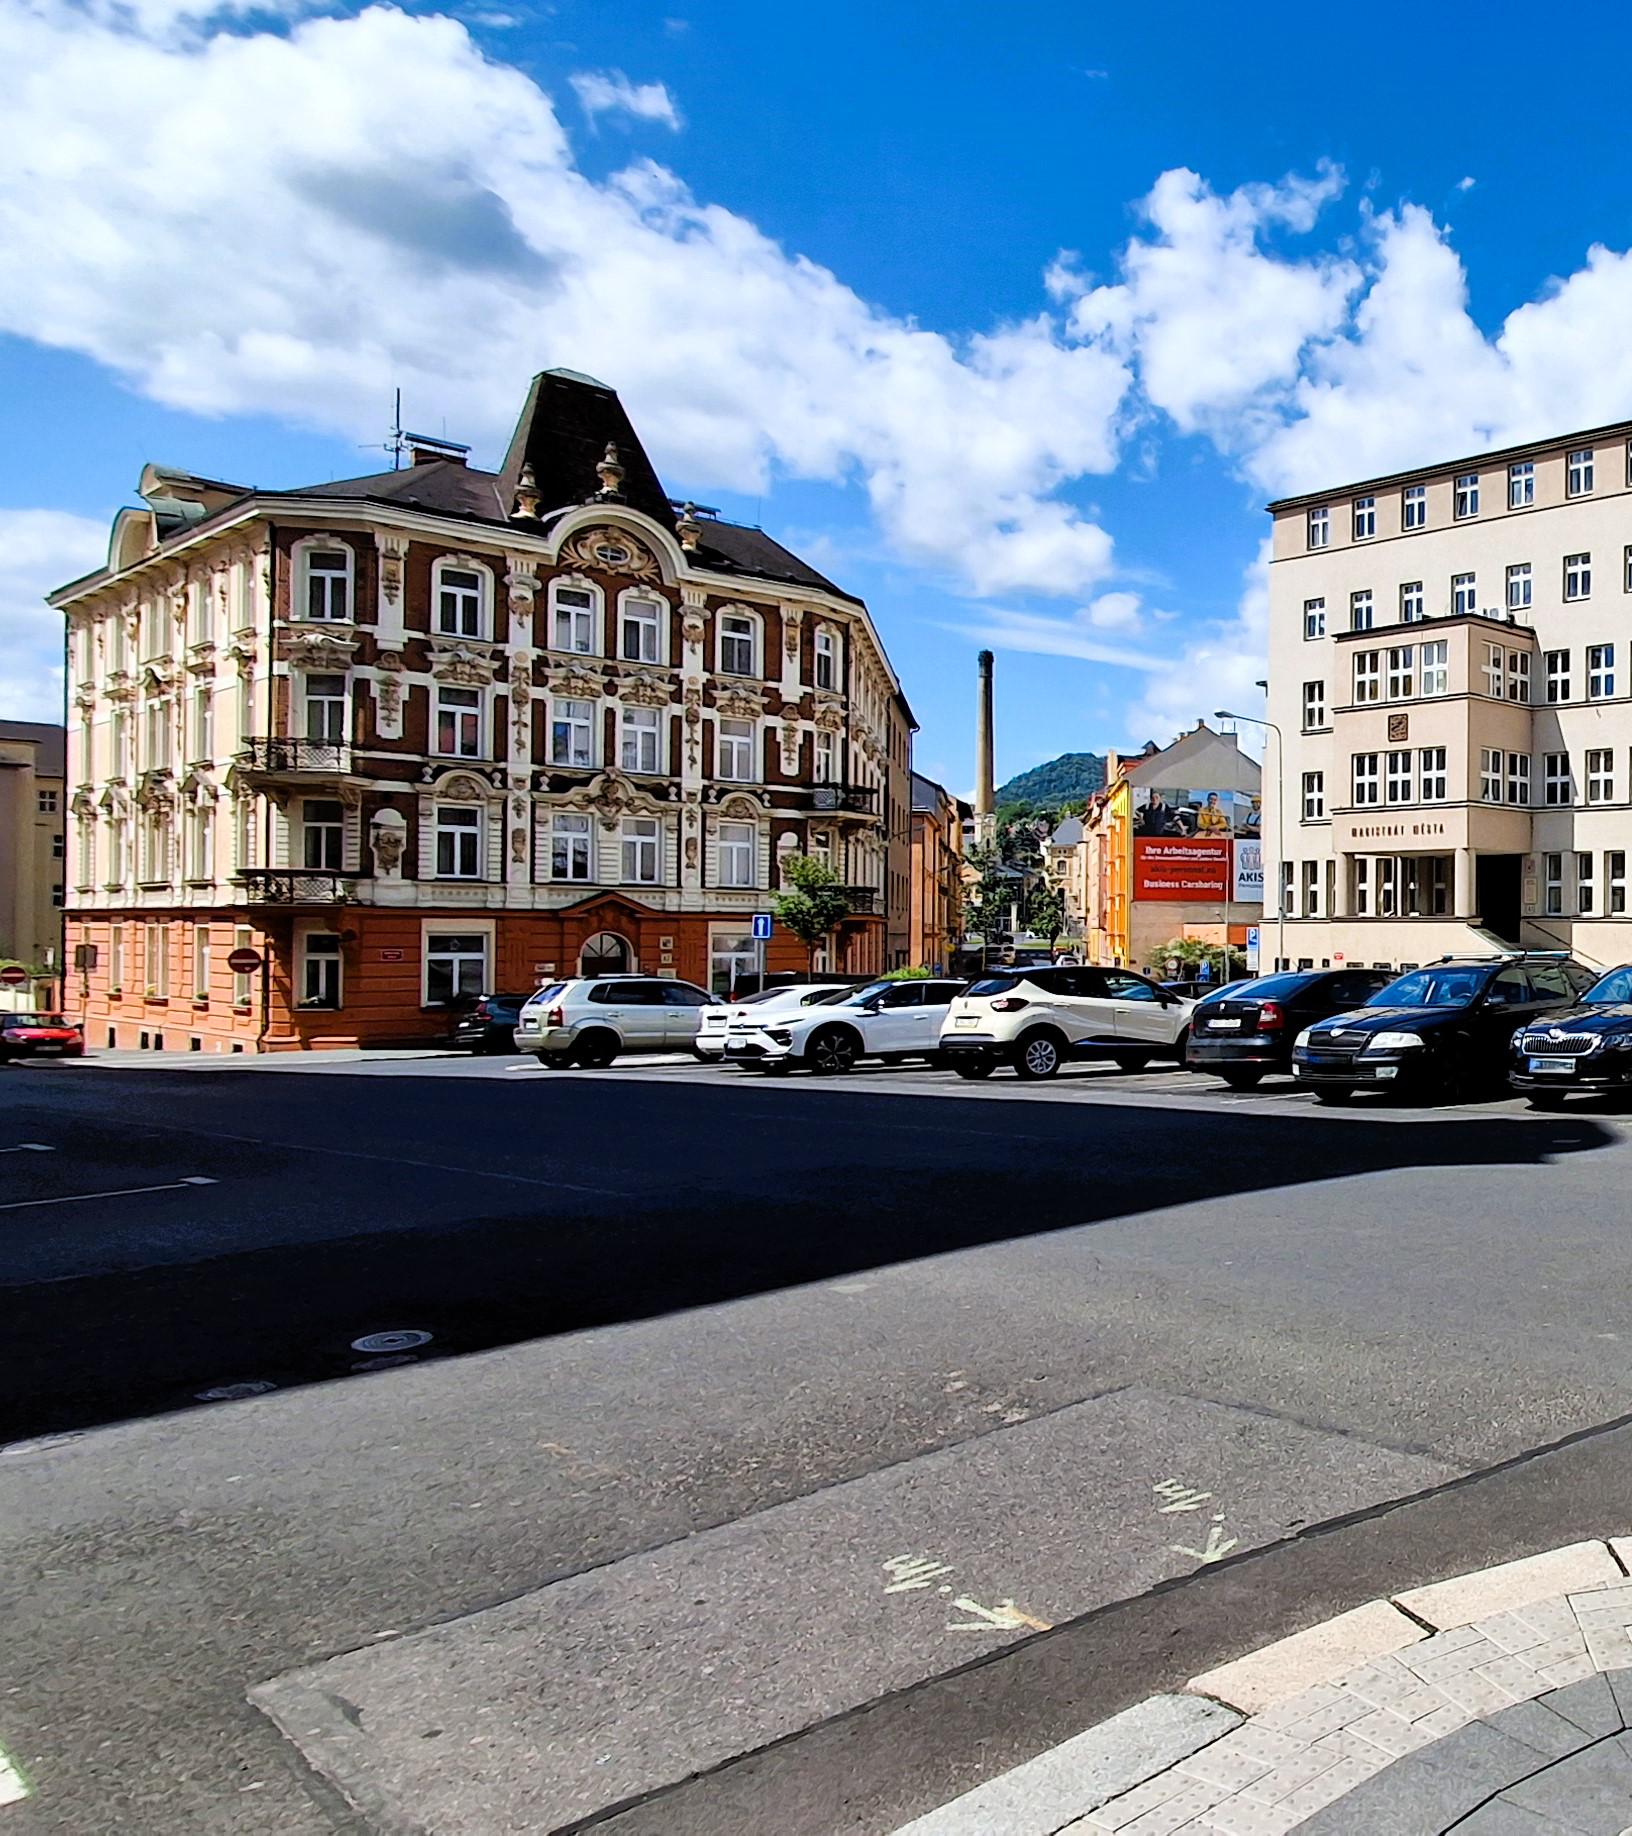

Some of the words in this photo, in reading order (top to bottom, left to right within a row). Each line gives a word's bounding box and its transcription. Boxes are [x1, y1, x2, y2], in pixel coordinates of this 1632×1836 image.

[1351, 824, 1404, 838] MAGISTRÁT
[1145, 846, 1161, 855] Ihre
[1163, 846, 1223, 858] Arbeitsagentur
[1238, 872, 1264, 882] AKIS
[1143, 880, 1180, 889] Business
[1181, 880, 1224, 891] Carsharing
